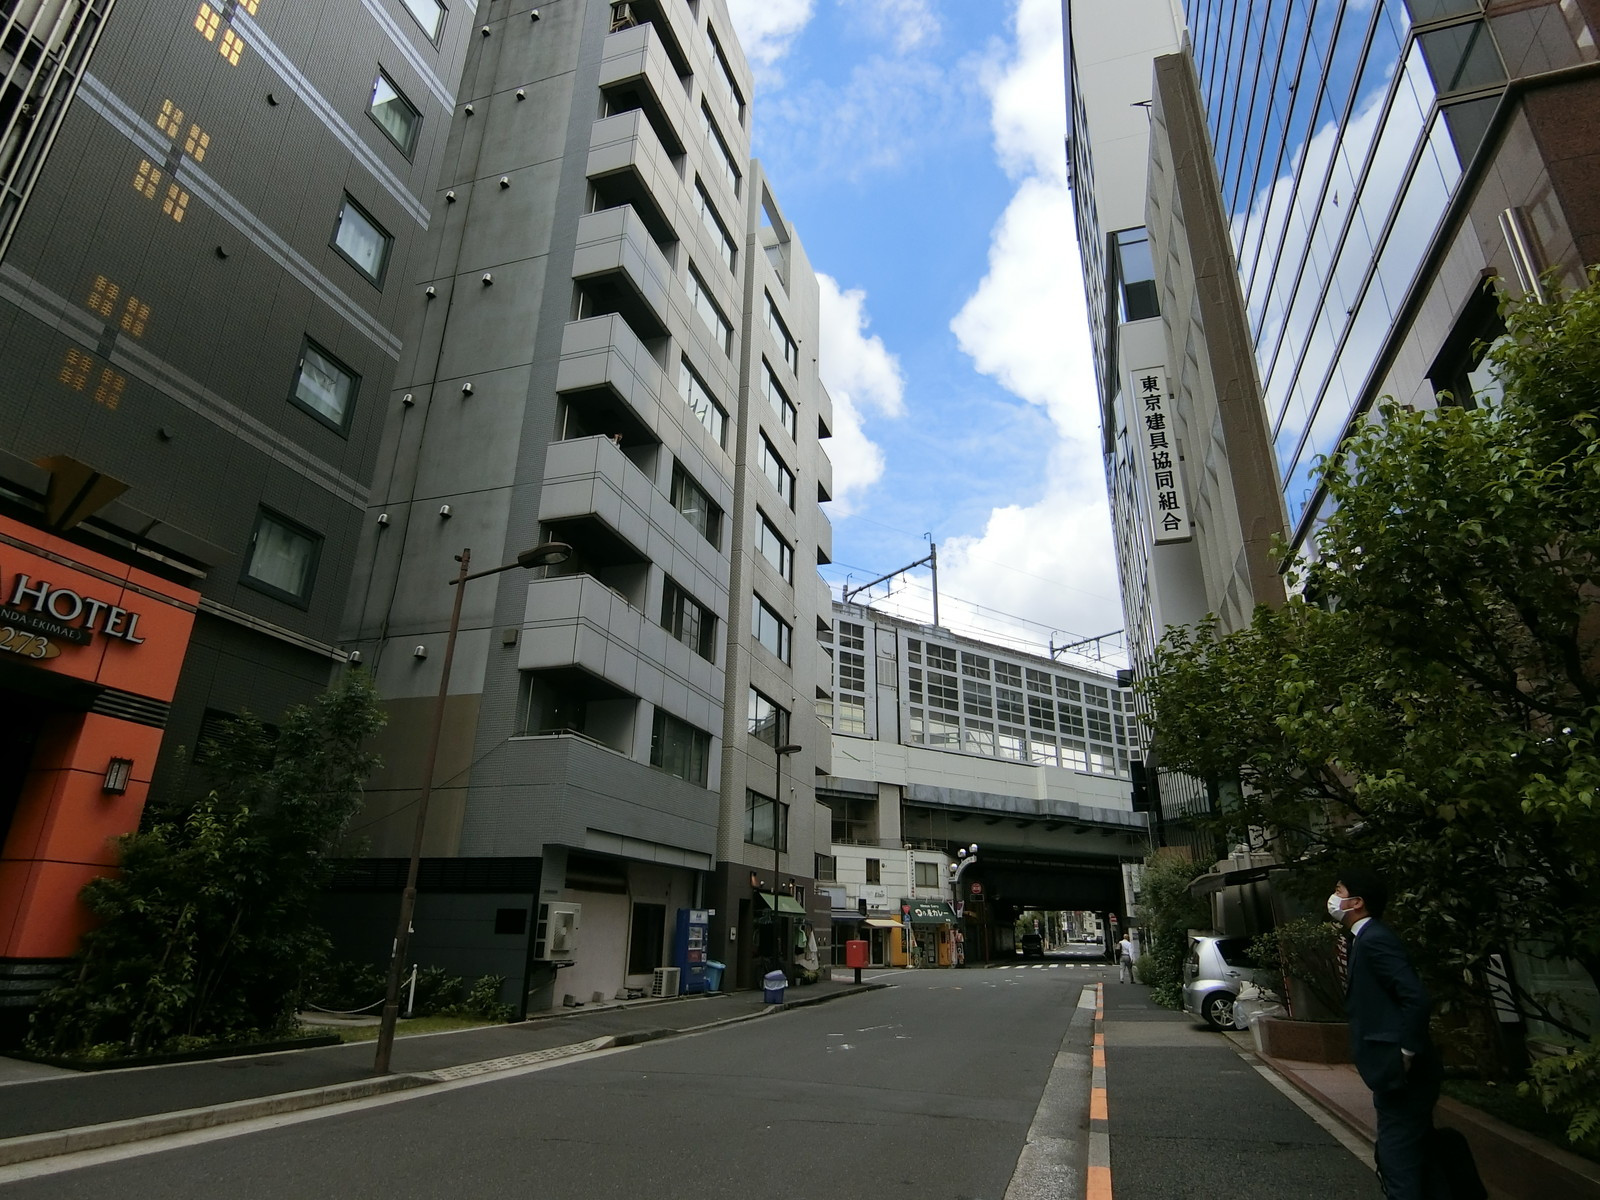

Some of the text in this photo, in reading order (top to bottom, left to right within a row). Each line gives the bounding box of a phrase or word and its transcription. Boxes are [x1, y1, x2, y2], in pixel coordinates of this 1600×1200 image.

[1139, 375, 1182, 531] 東京建具協同組合
[0, 626, 48, 659] 273
[11, 574, 146, 644] HOTEL
